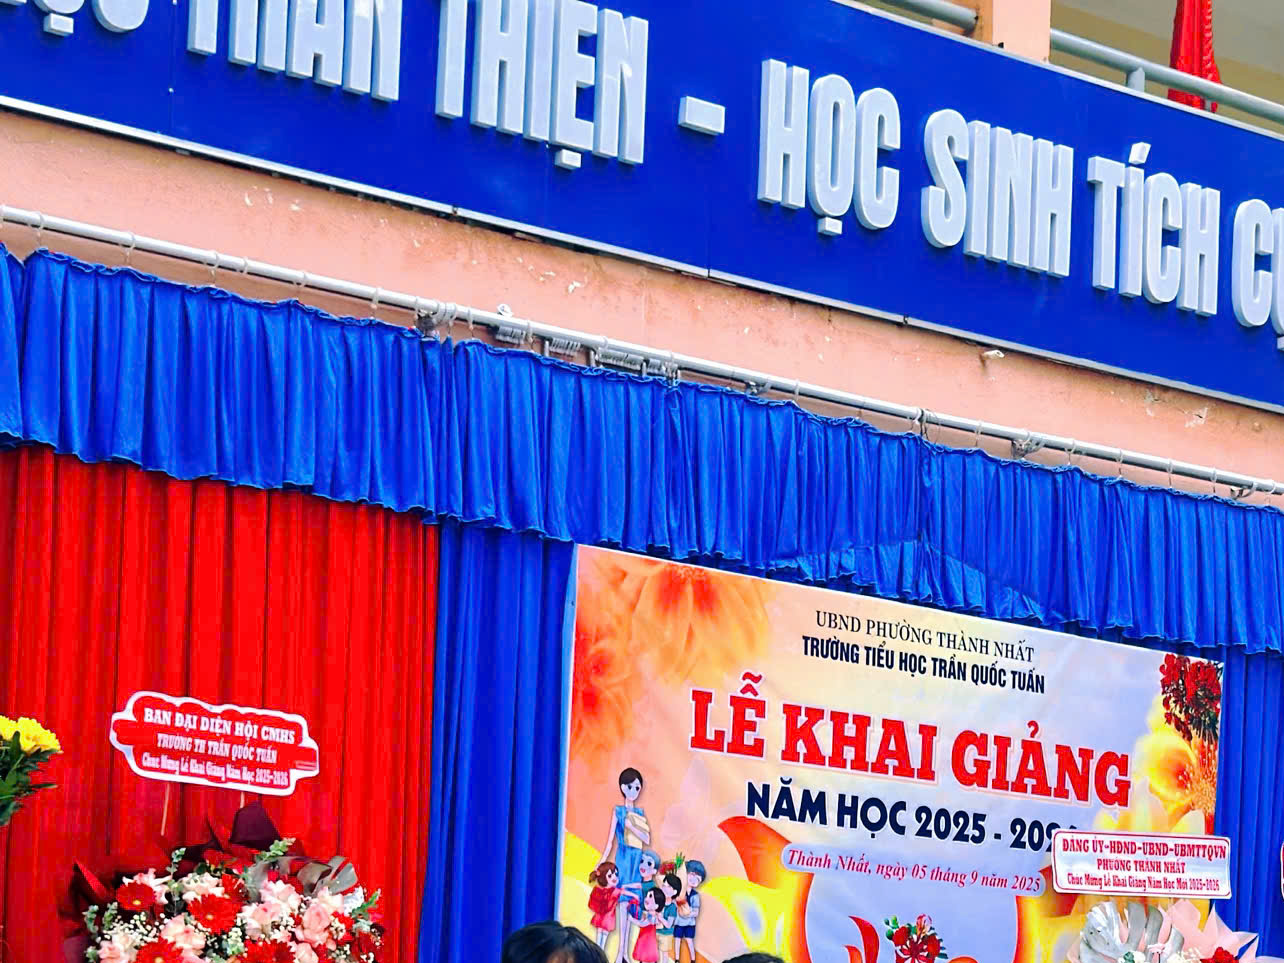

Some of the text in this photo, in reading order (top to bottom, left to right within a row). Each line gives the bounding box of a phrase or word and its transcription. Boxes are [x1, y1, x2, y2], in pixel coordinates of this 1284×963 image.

[757, 58, 901, 236] HỌC
[920, 108, 1074, 279] SINH
[1086, 141, 1220, 317] TÍCH
[816, 610, 1035, 663] UBND PHƯỜNG THÀNH NHẤT
[802, 636, 1045, 694] TRƯỜNG TIỂU HỌC TRẦN QUỐC TUẤN
[144, 708, 296, 744] BAN ĐẠI DIỆN HỘI CMHS
[193, 738, 206, 753] TH
[232, 742, 254, 761] QUỐC
[689, 672, 1131, 808] LỄ KHAI GIẢNG
[746, 777, 827, 825] NĂM
[836, 795, 906, 839] HỌC
[915, 805, 986, 843] 2025
[1009, 817, 1077, 853] 202
[1062, 836, 1089, 852] ĐẢNG
[787, 849, 1041, 892] Thành Nhất, ngày 05 tháng 9 năm 2025
[1189, 879, 1220, 891] 2025-2026
